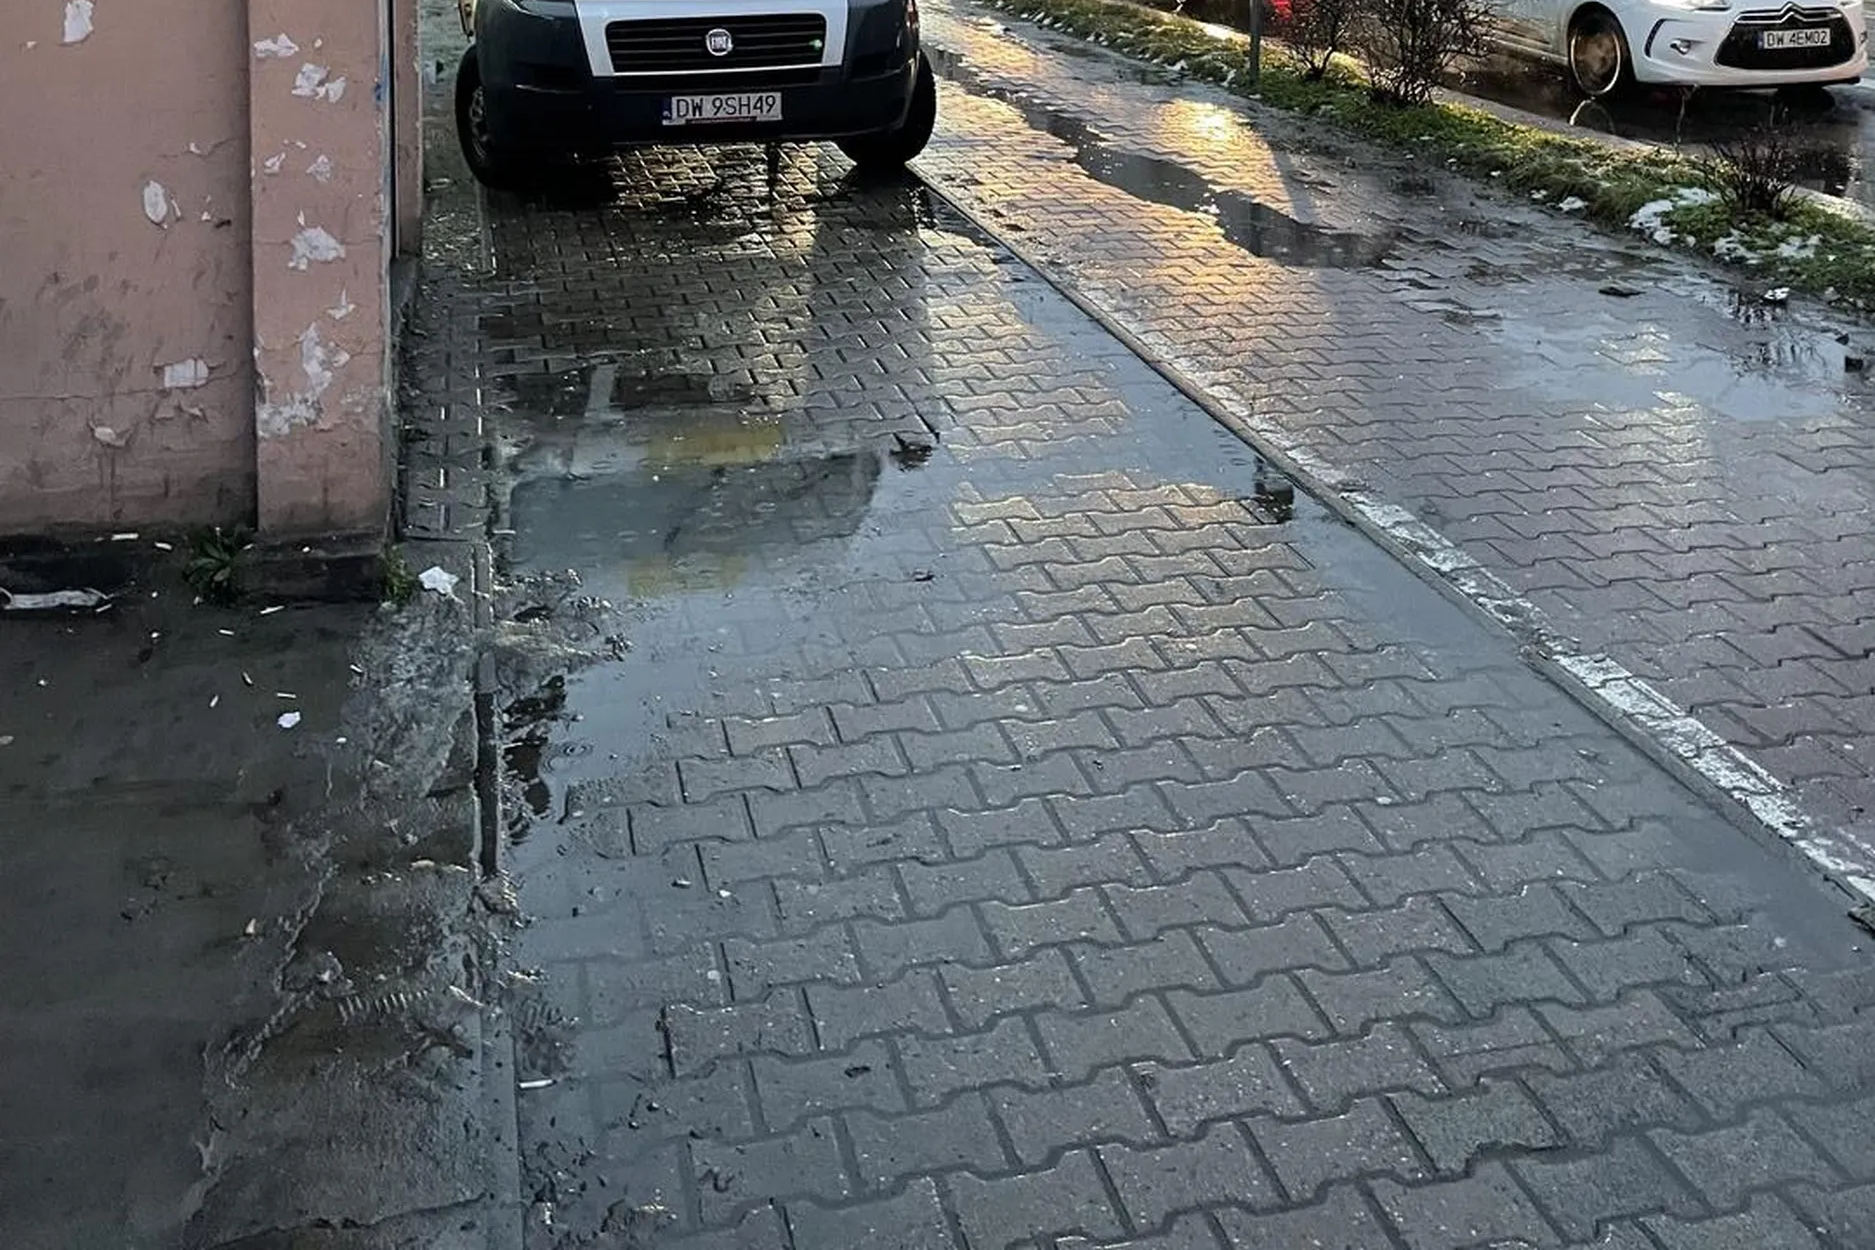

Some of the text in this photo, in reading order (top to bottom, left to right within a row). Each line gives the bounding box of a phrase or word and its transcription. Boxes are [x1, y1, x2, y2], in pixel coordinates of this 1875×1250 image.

[1766, 32, 1784, 48] DW
[676, 94, 776, 118] DW 9SH49
